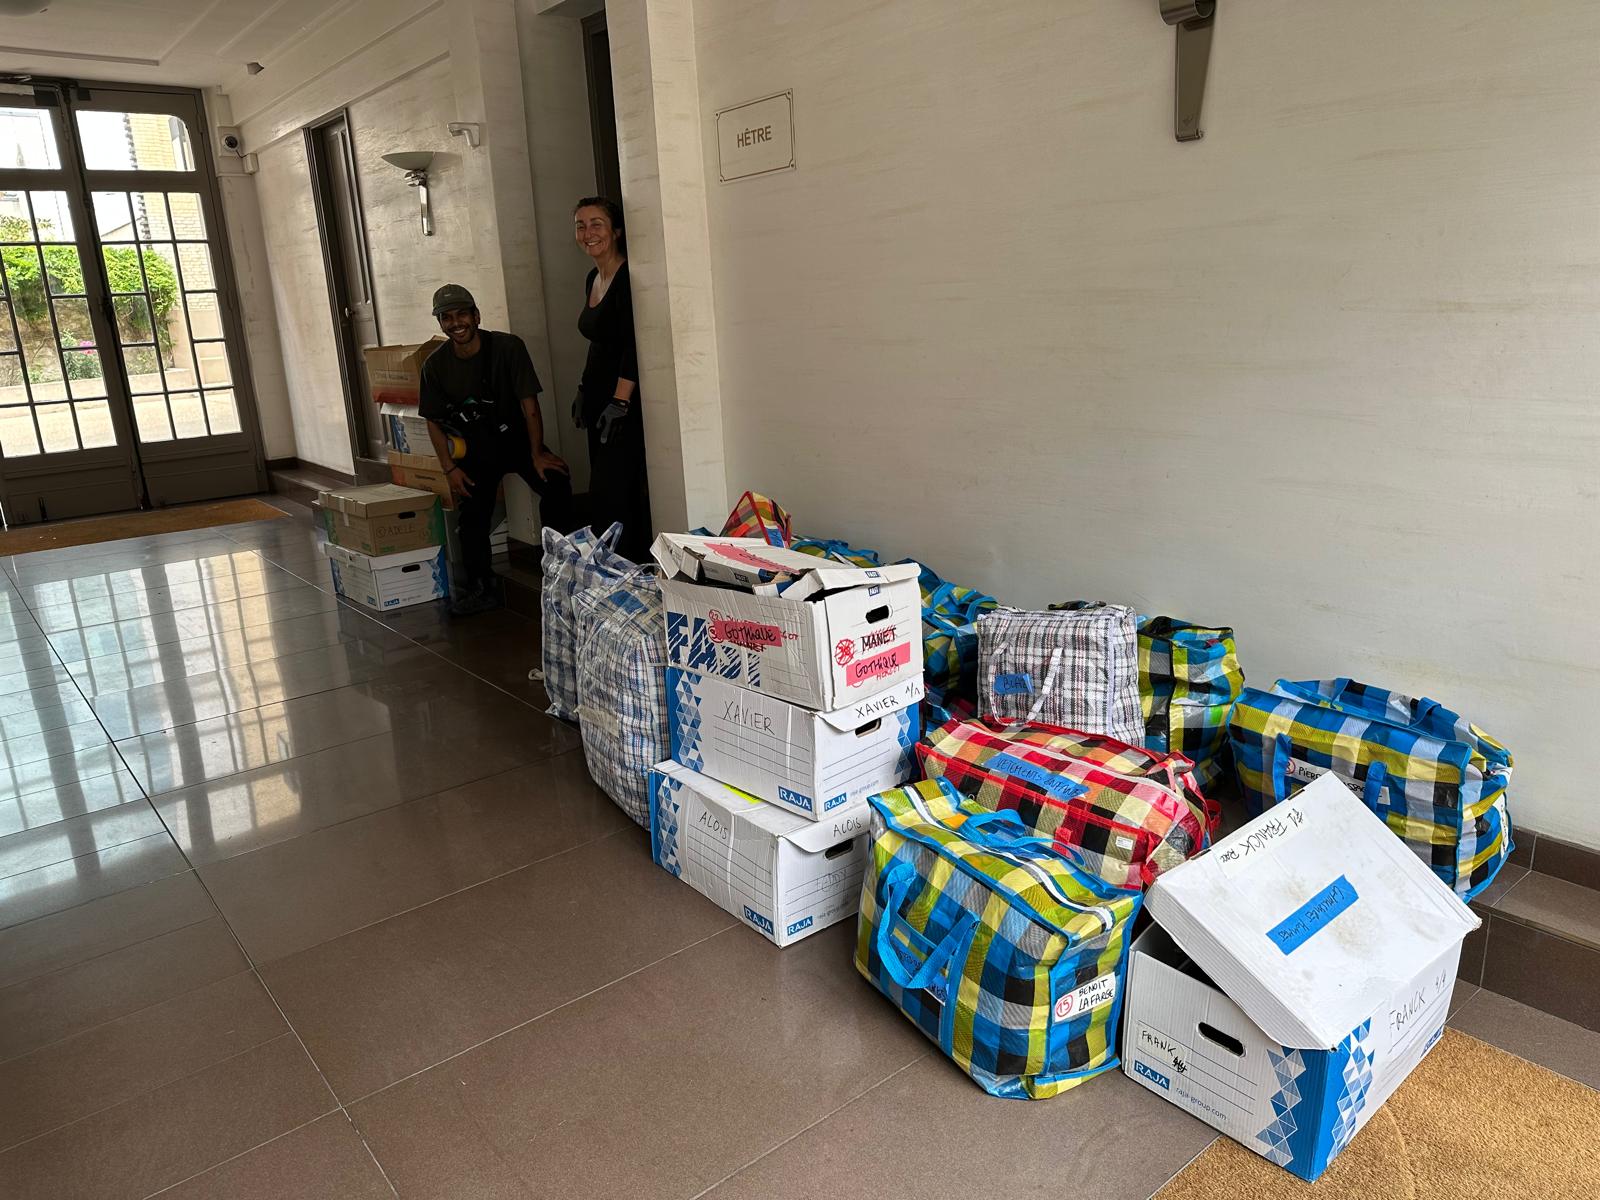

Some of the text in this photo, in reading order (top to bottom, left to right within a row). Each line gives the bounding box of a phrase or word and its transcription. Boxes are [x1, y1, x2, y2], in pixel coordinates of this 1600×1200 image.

[737, 125, 772, 148] HÊTRE
[860, 627, 897, 651] MANET
[723, 701, 775, 735] XAVIER
[856, 695, 898, 718] XAVIER
[780, 788, 811, 810] RAJA
[825, 795, 846, 810] RAJA
[833, 817, 862, 837] ALOIS
[744, 908, 773, 934] RAJA
[788, 918, 812, 935] RAJA
[1389, 987, 1426, 1031] FRANCK
[1142, 1030, 1176, 1057] FRANK
[1135, 1062, 1168, 1088] RAJA
[1175, 1087, 1227, 1121] raja-group.com
